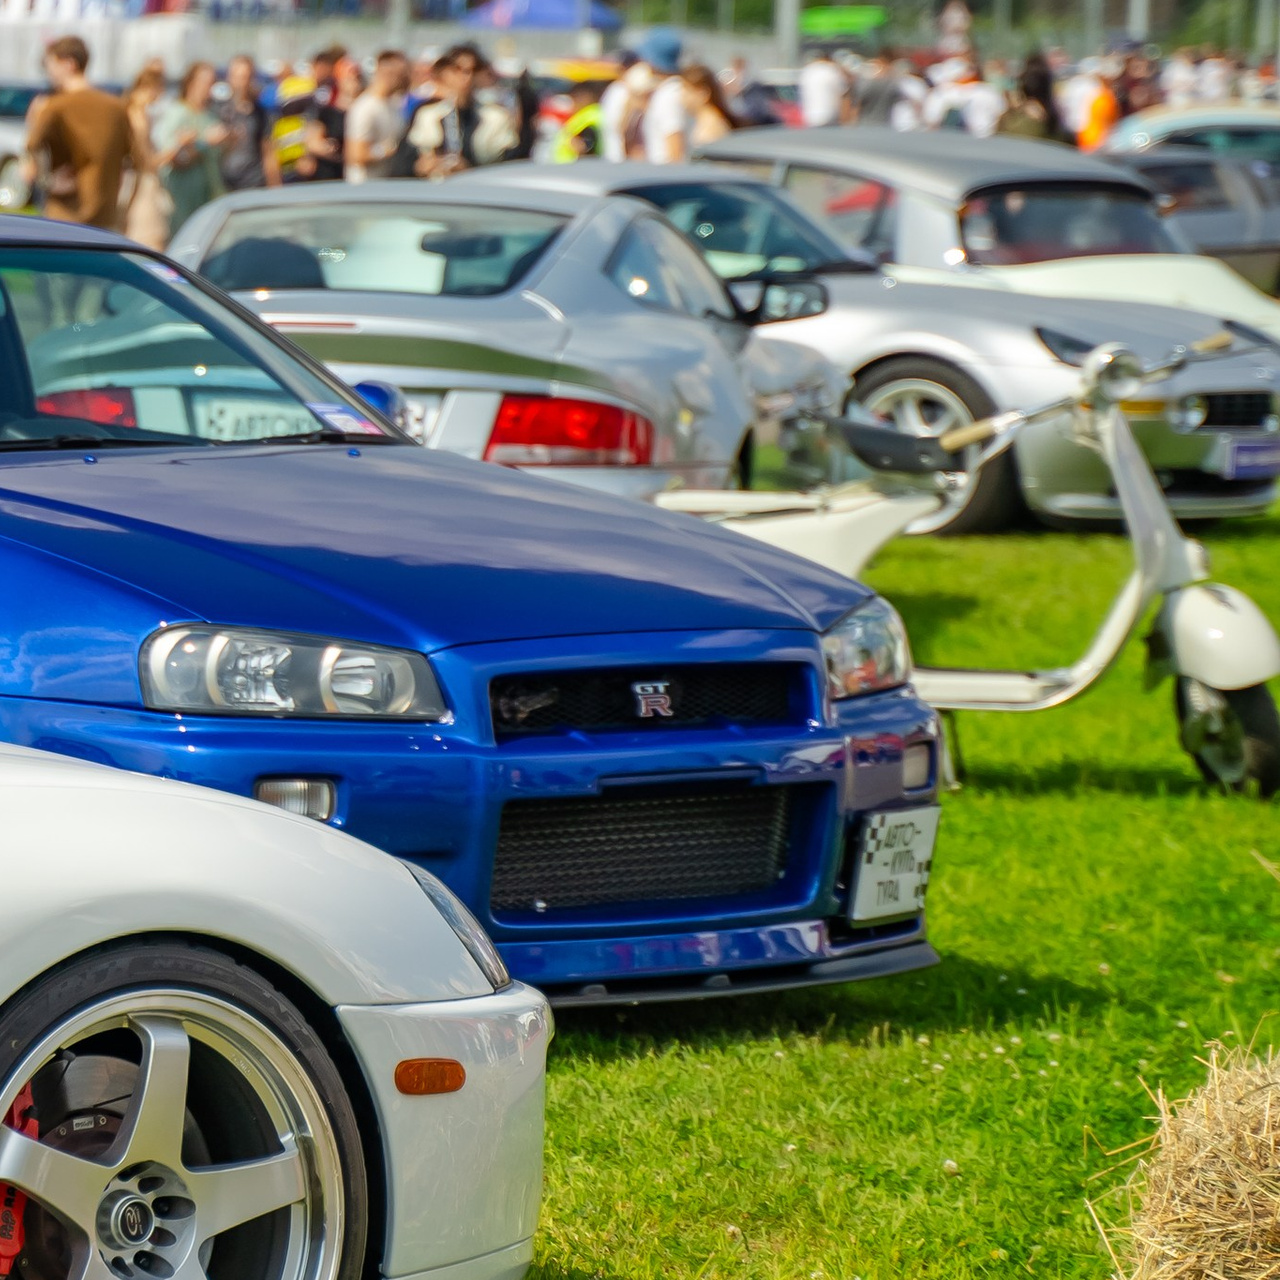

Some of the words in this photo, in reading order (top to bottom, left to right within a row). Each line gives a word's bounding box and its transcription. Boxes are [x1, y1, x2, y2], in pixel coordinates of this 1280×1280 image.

[635, 682, 671, 694] GT
[638, 694, 674, 717] R
[877, 879, 899, 907] ТУРА
